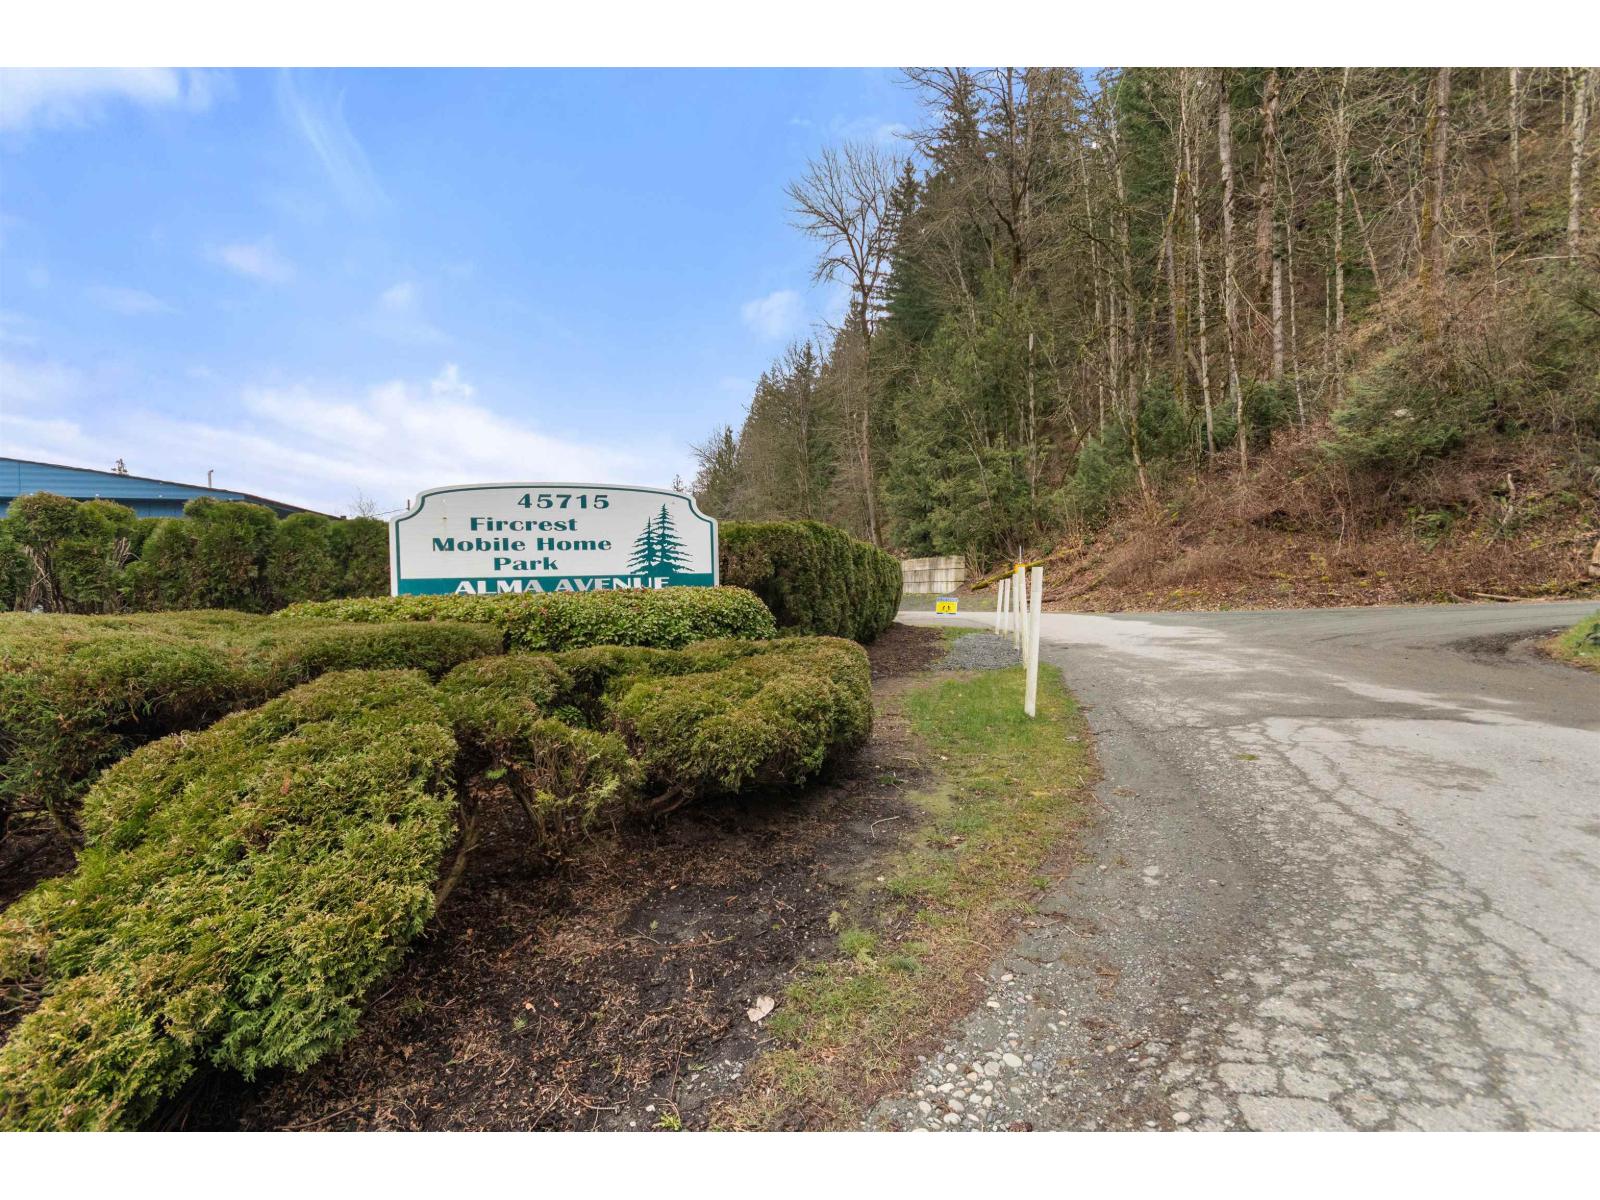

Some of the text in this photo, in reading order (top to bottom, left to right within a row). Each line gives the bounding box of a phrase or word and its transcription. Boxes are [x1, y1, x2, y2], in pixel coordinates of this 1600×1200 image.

[517, 493, 610, 509] 45715
[470, 517, 578, 531] Fircrest
[432, 537, 612, 552] Mobile Home
[493, 557, 559, 571] Park
[454, 577, 670, 595] ALMA AVENUE
